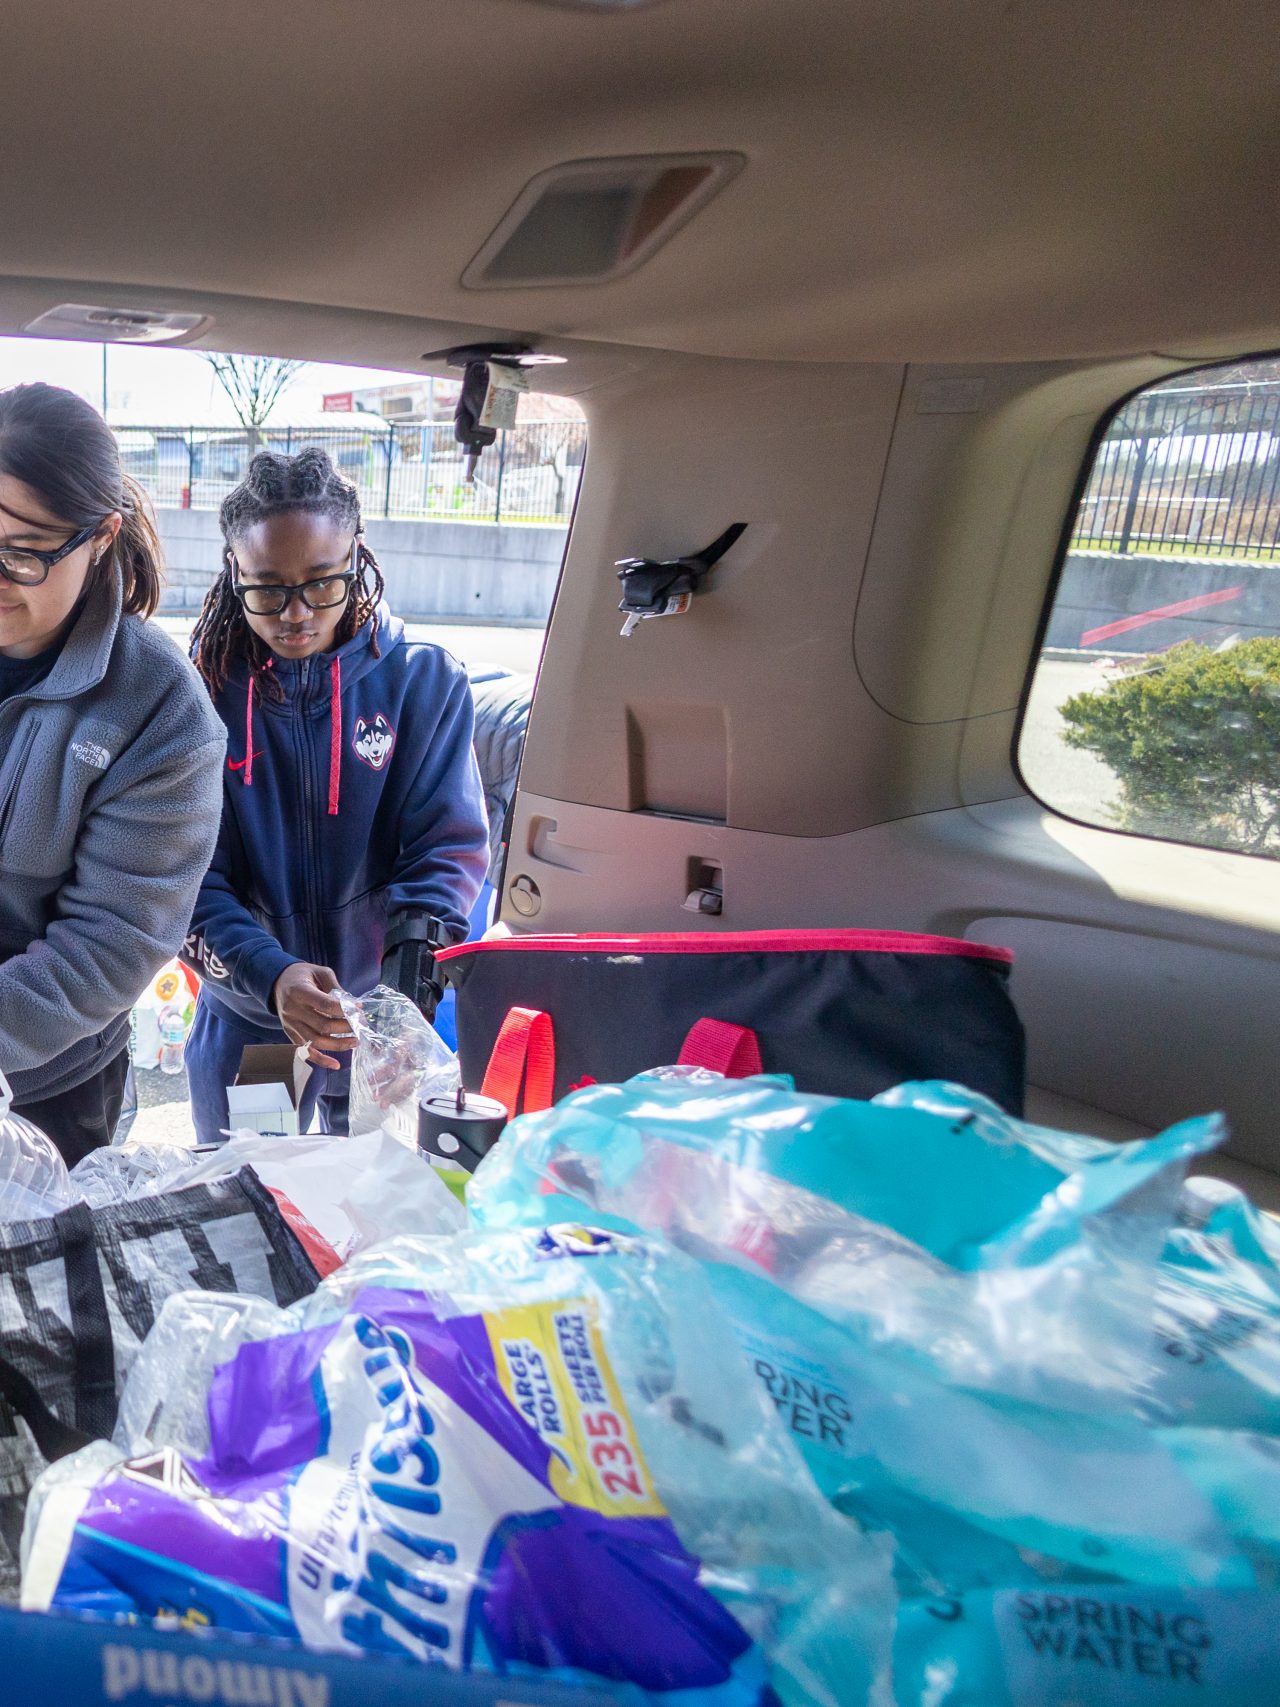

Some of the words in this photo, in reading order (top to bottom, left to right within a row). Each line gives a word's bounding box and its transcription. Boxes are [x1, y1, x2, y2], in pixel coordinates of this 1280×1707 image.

[70, 742, 100, 758] NORTH
[75, 752, 95, 766] FACE
[86, 741, 102, 753] THE
[183, 934, 230, 979] KIES
[555, 1314, 592, 1404] SHEETS
[574, 1314, 591, 1361] ROLL
[586, 1366, 607, 1404] PER
[754, 1359, 852, 1422] RING
[770, 1396, 844, 1446] TER
[584, 1411, 643, 1496] 235
[1014, 1594, 1212, 1650] SPRING
[1021, 1620, 1203, 1685] WATER
